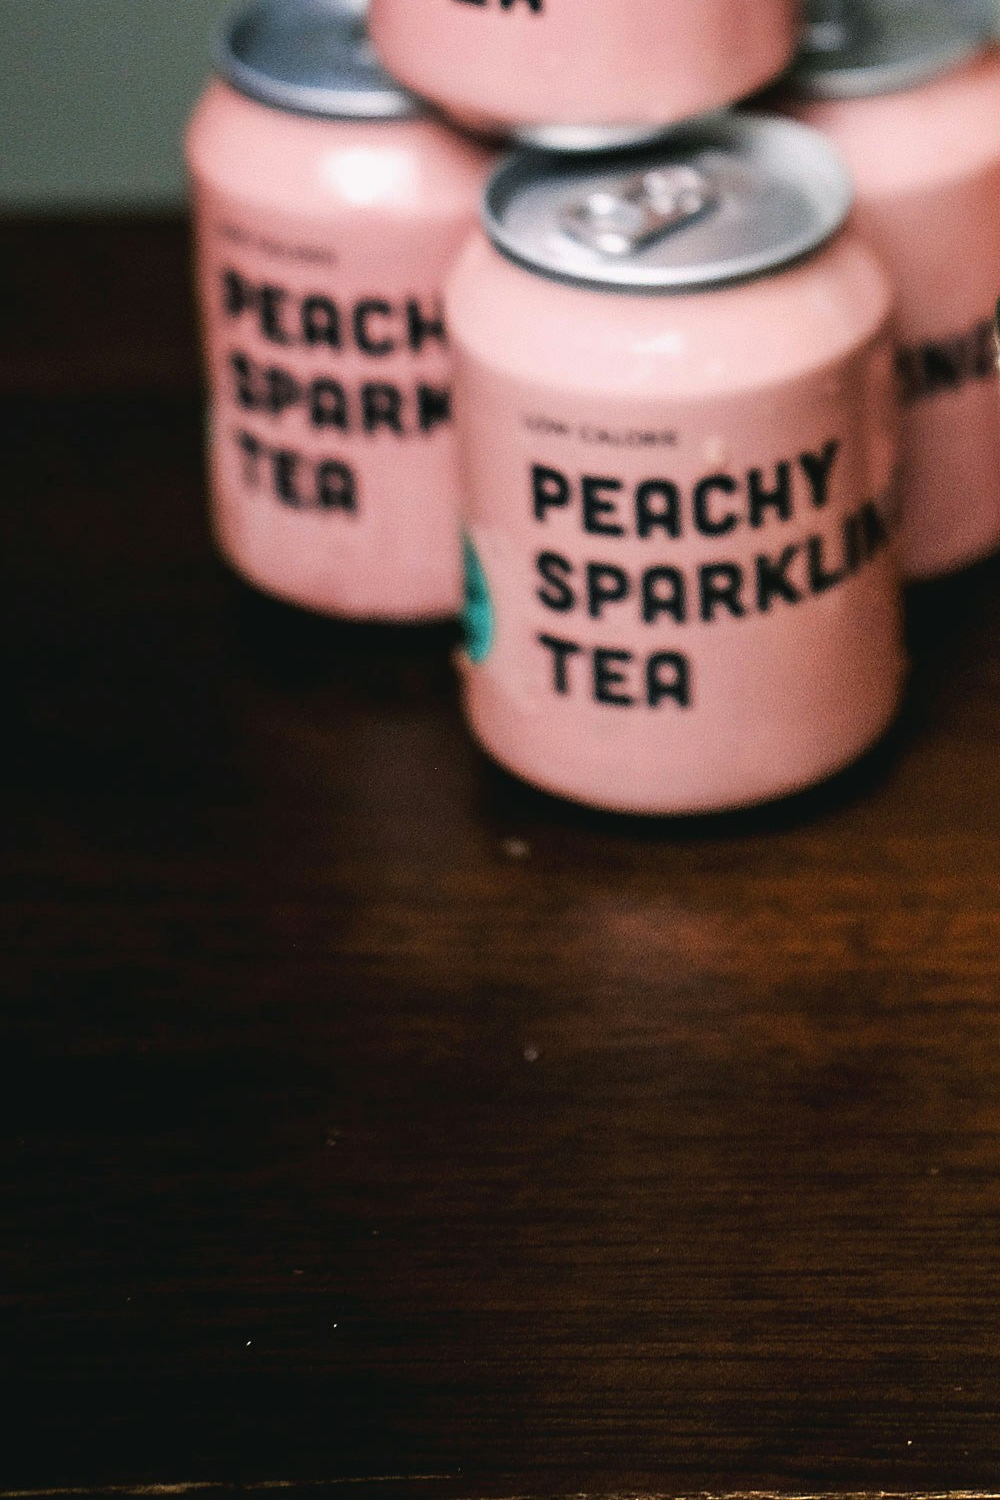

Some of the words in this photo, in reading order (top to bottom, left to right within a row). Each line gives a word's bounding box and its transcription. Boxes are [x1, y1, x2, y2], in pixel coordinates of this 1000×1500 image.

[222, 266, 447, 357] PEACH
[530, 439, 839, 539] PEACHY
[535, 500, 888, 624] SPARKLIN
[537, 632, 691, 710] TEA
